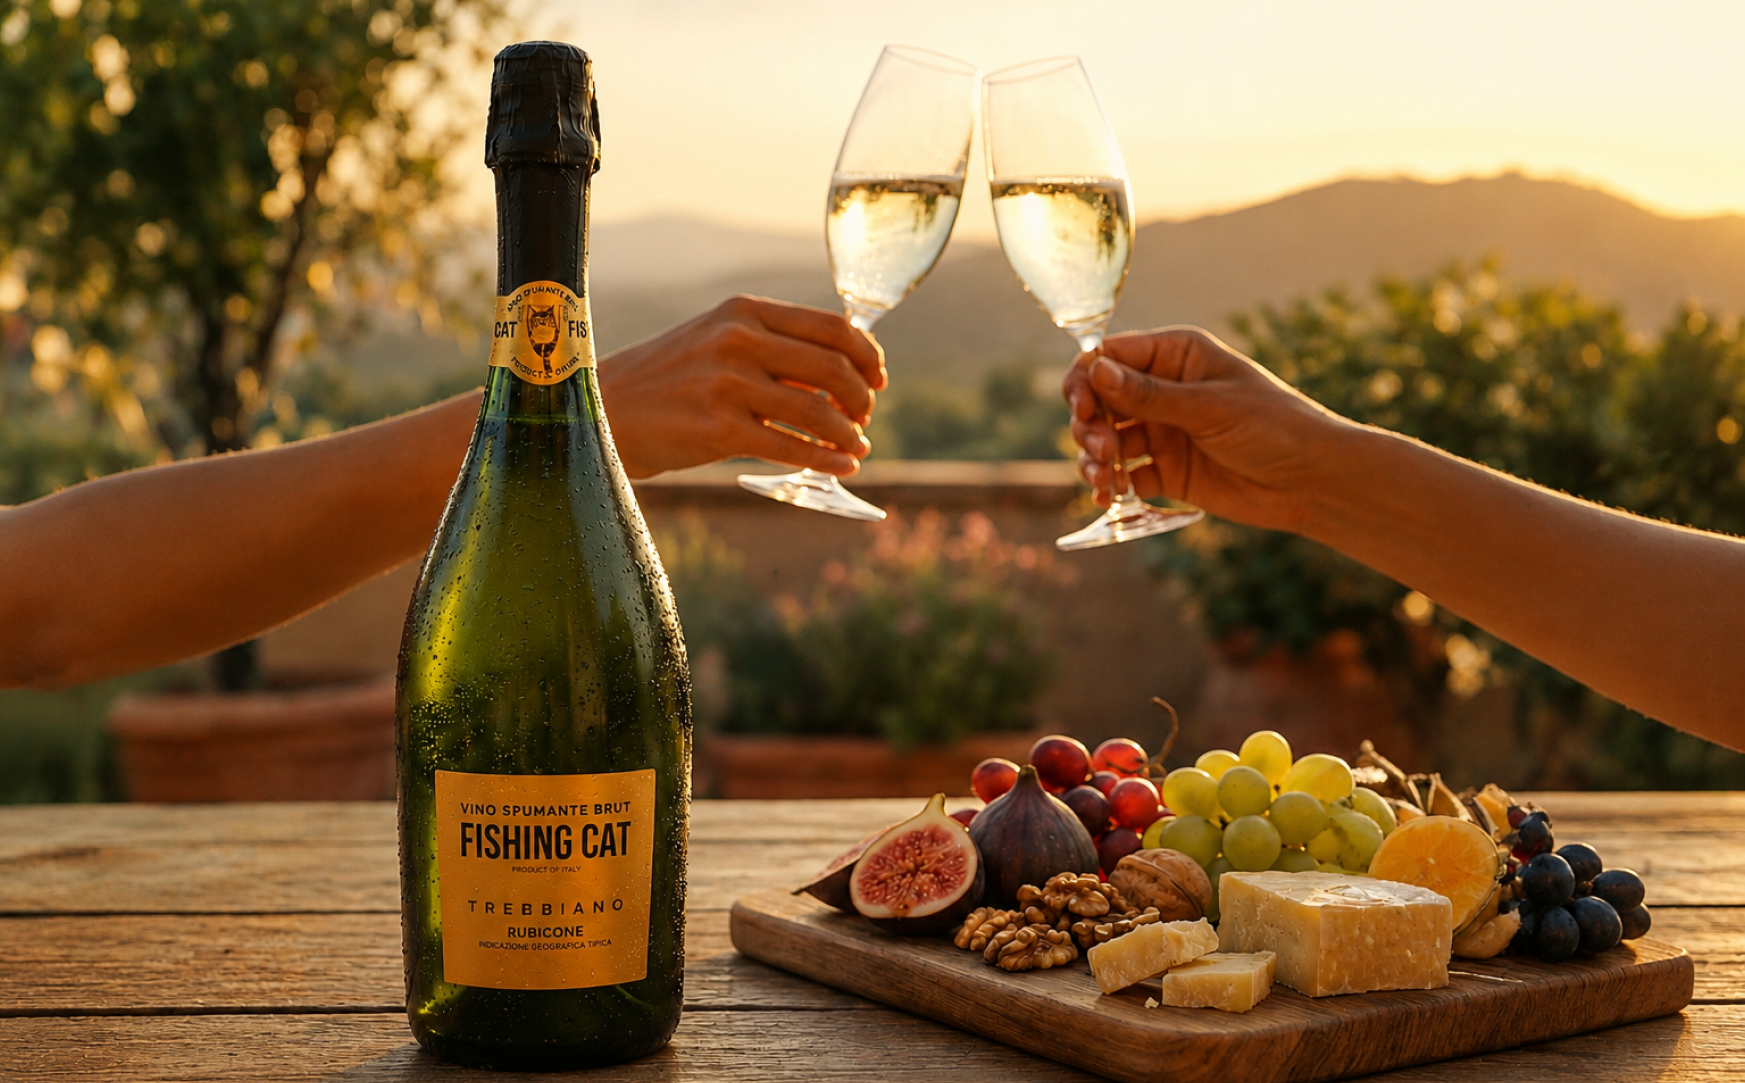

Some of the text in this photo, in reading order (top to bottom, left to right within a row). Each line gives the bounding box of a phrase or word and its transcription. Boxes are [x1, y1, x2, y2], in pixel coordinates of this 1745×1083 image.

[494, 321, 518, 338] CAT
[568, 320, 587, 338] FIS
[460, 801, 631, 817] VINO SPUMANTE BRUT
[460, 821, 632, 860] FISHING CAT
[511, 866, 548, 874] PRODUCT
[561, 865, 582, 873] ITALY
[467, 898, 624, 916] TREBBIANO
[507, 925, 584, 938] RUBICONE
[478, 938, 613, 951] INDICAZIONE GEOGRAFICA TIPICA
